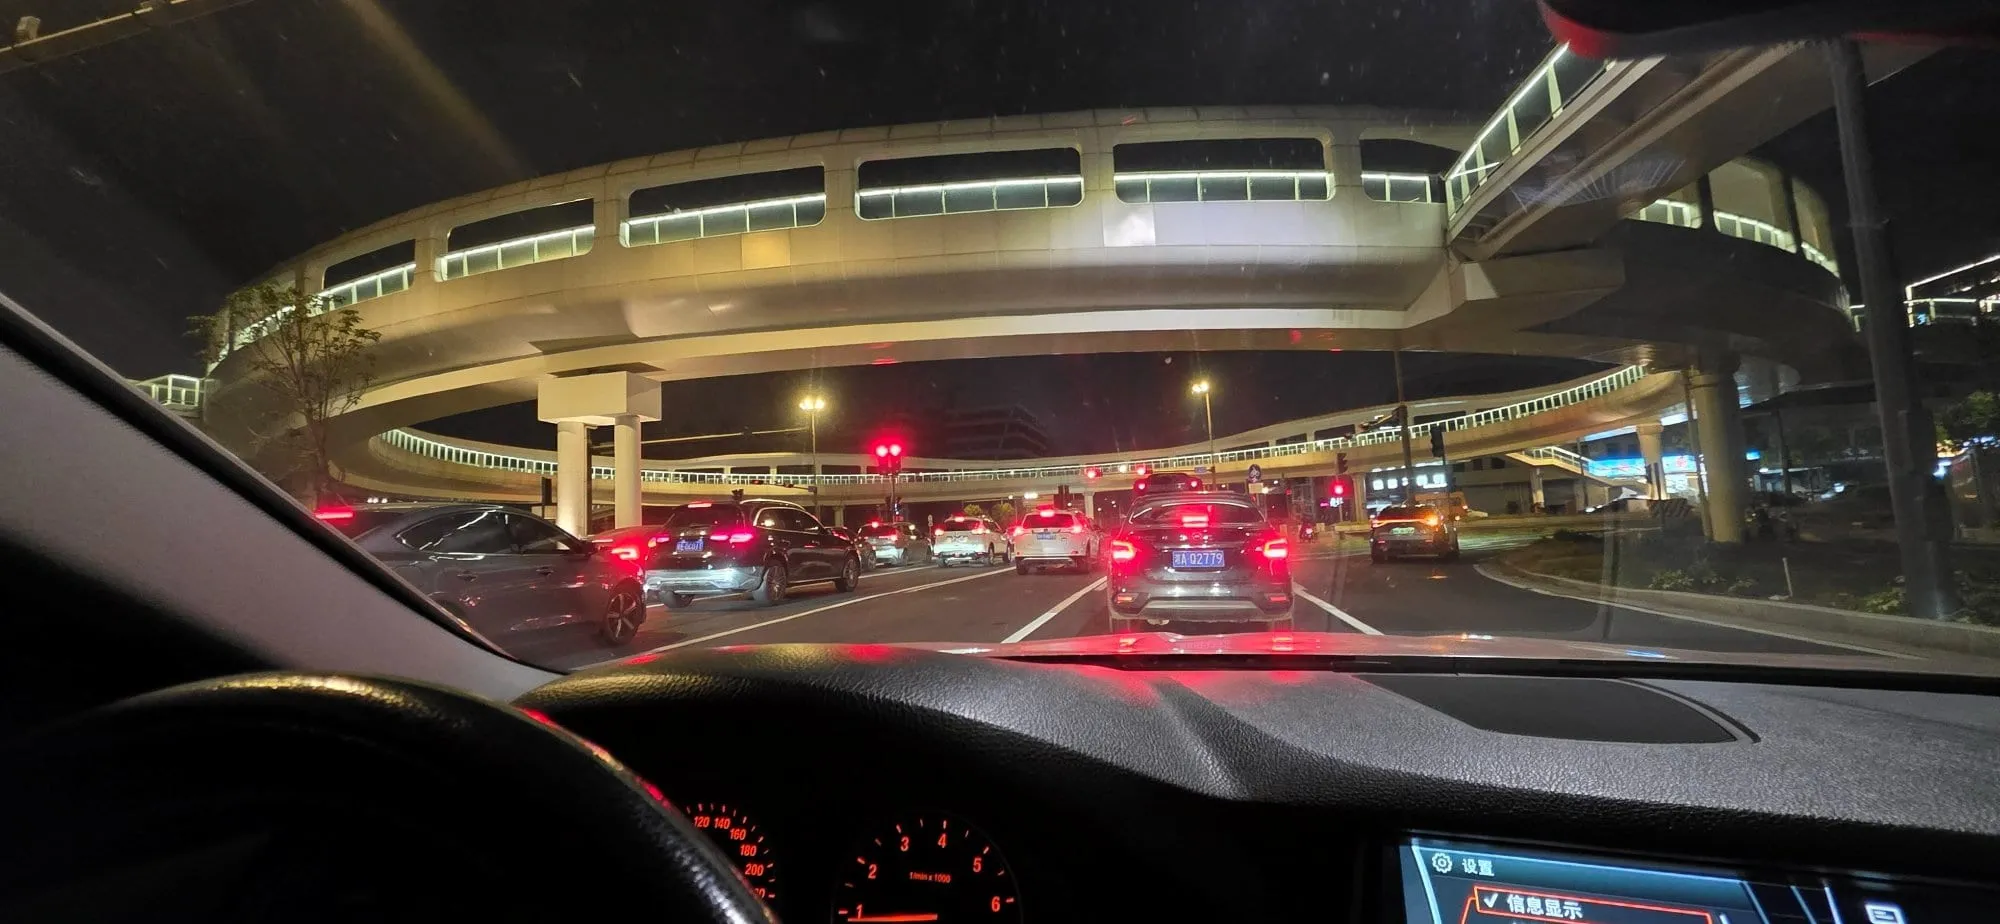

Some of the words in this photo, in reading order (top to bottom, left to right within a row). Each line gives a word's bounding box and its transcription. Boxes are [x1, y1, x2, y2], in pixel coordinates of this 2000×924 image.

[694, 816, 710, 828] 120
[714, 817, 731, 829] 140
[730, 828, 747, 840] 160
[937, 833, 947, 848] 4
[740, 844, 757, 857] 180
[900, 836, 909, 851] 3
[745, 863, 764, 876] 200
[868, 864, 877, 879] 2
[973, 857, 982, 873] 5
[1462, 858, 1495, 877] 设置
[856, 904, 863, 919] 1
[991, 896, 1000, 912] 6
[1507, 893, 1583, 920] 信息显示
